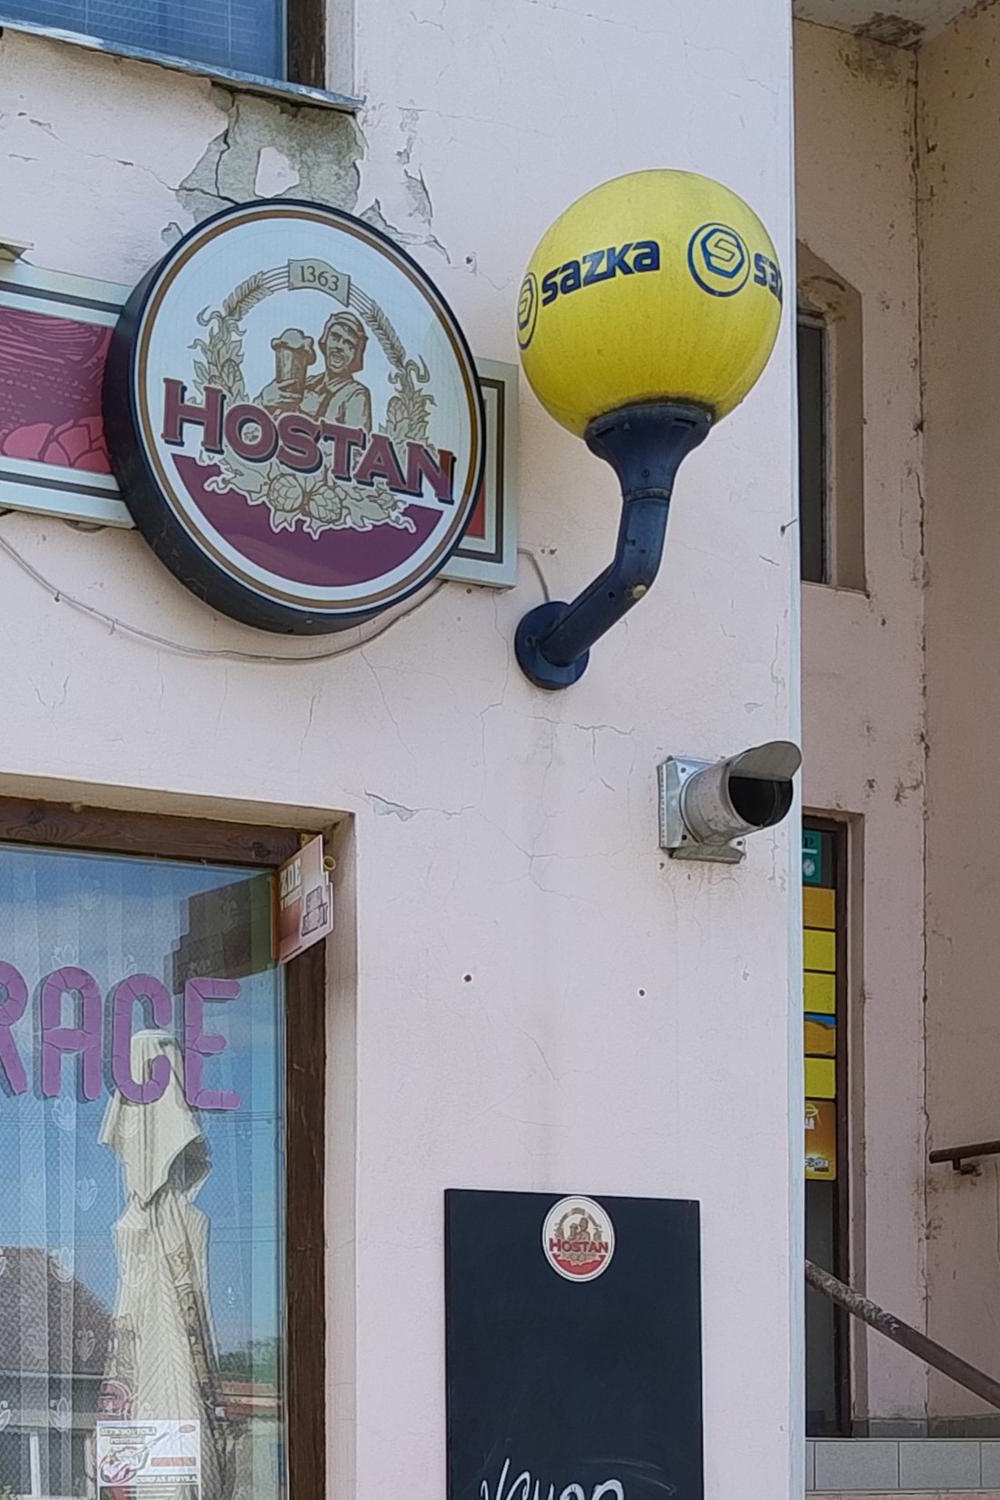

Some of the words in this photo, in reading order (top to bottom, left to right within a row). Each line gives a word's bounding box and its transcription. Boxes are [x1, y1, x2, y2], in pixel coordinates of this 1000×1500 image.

[300, 265, 340, 292] 1363
[161, 377, 457, 505] HOSTAN
[548, 1238, 609, 1254] HOSTAN
